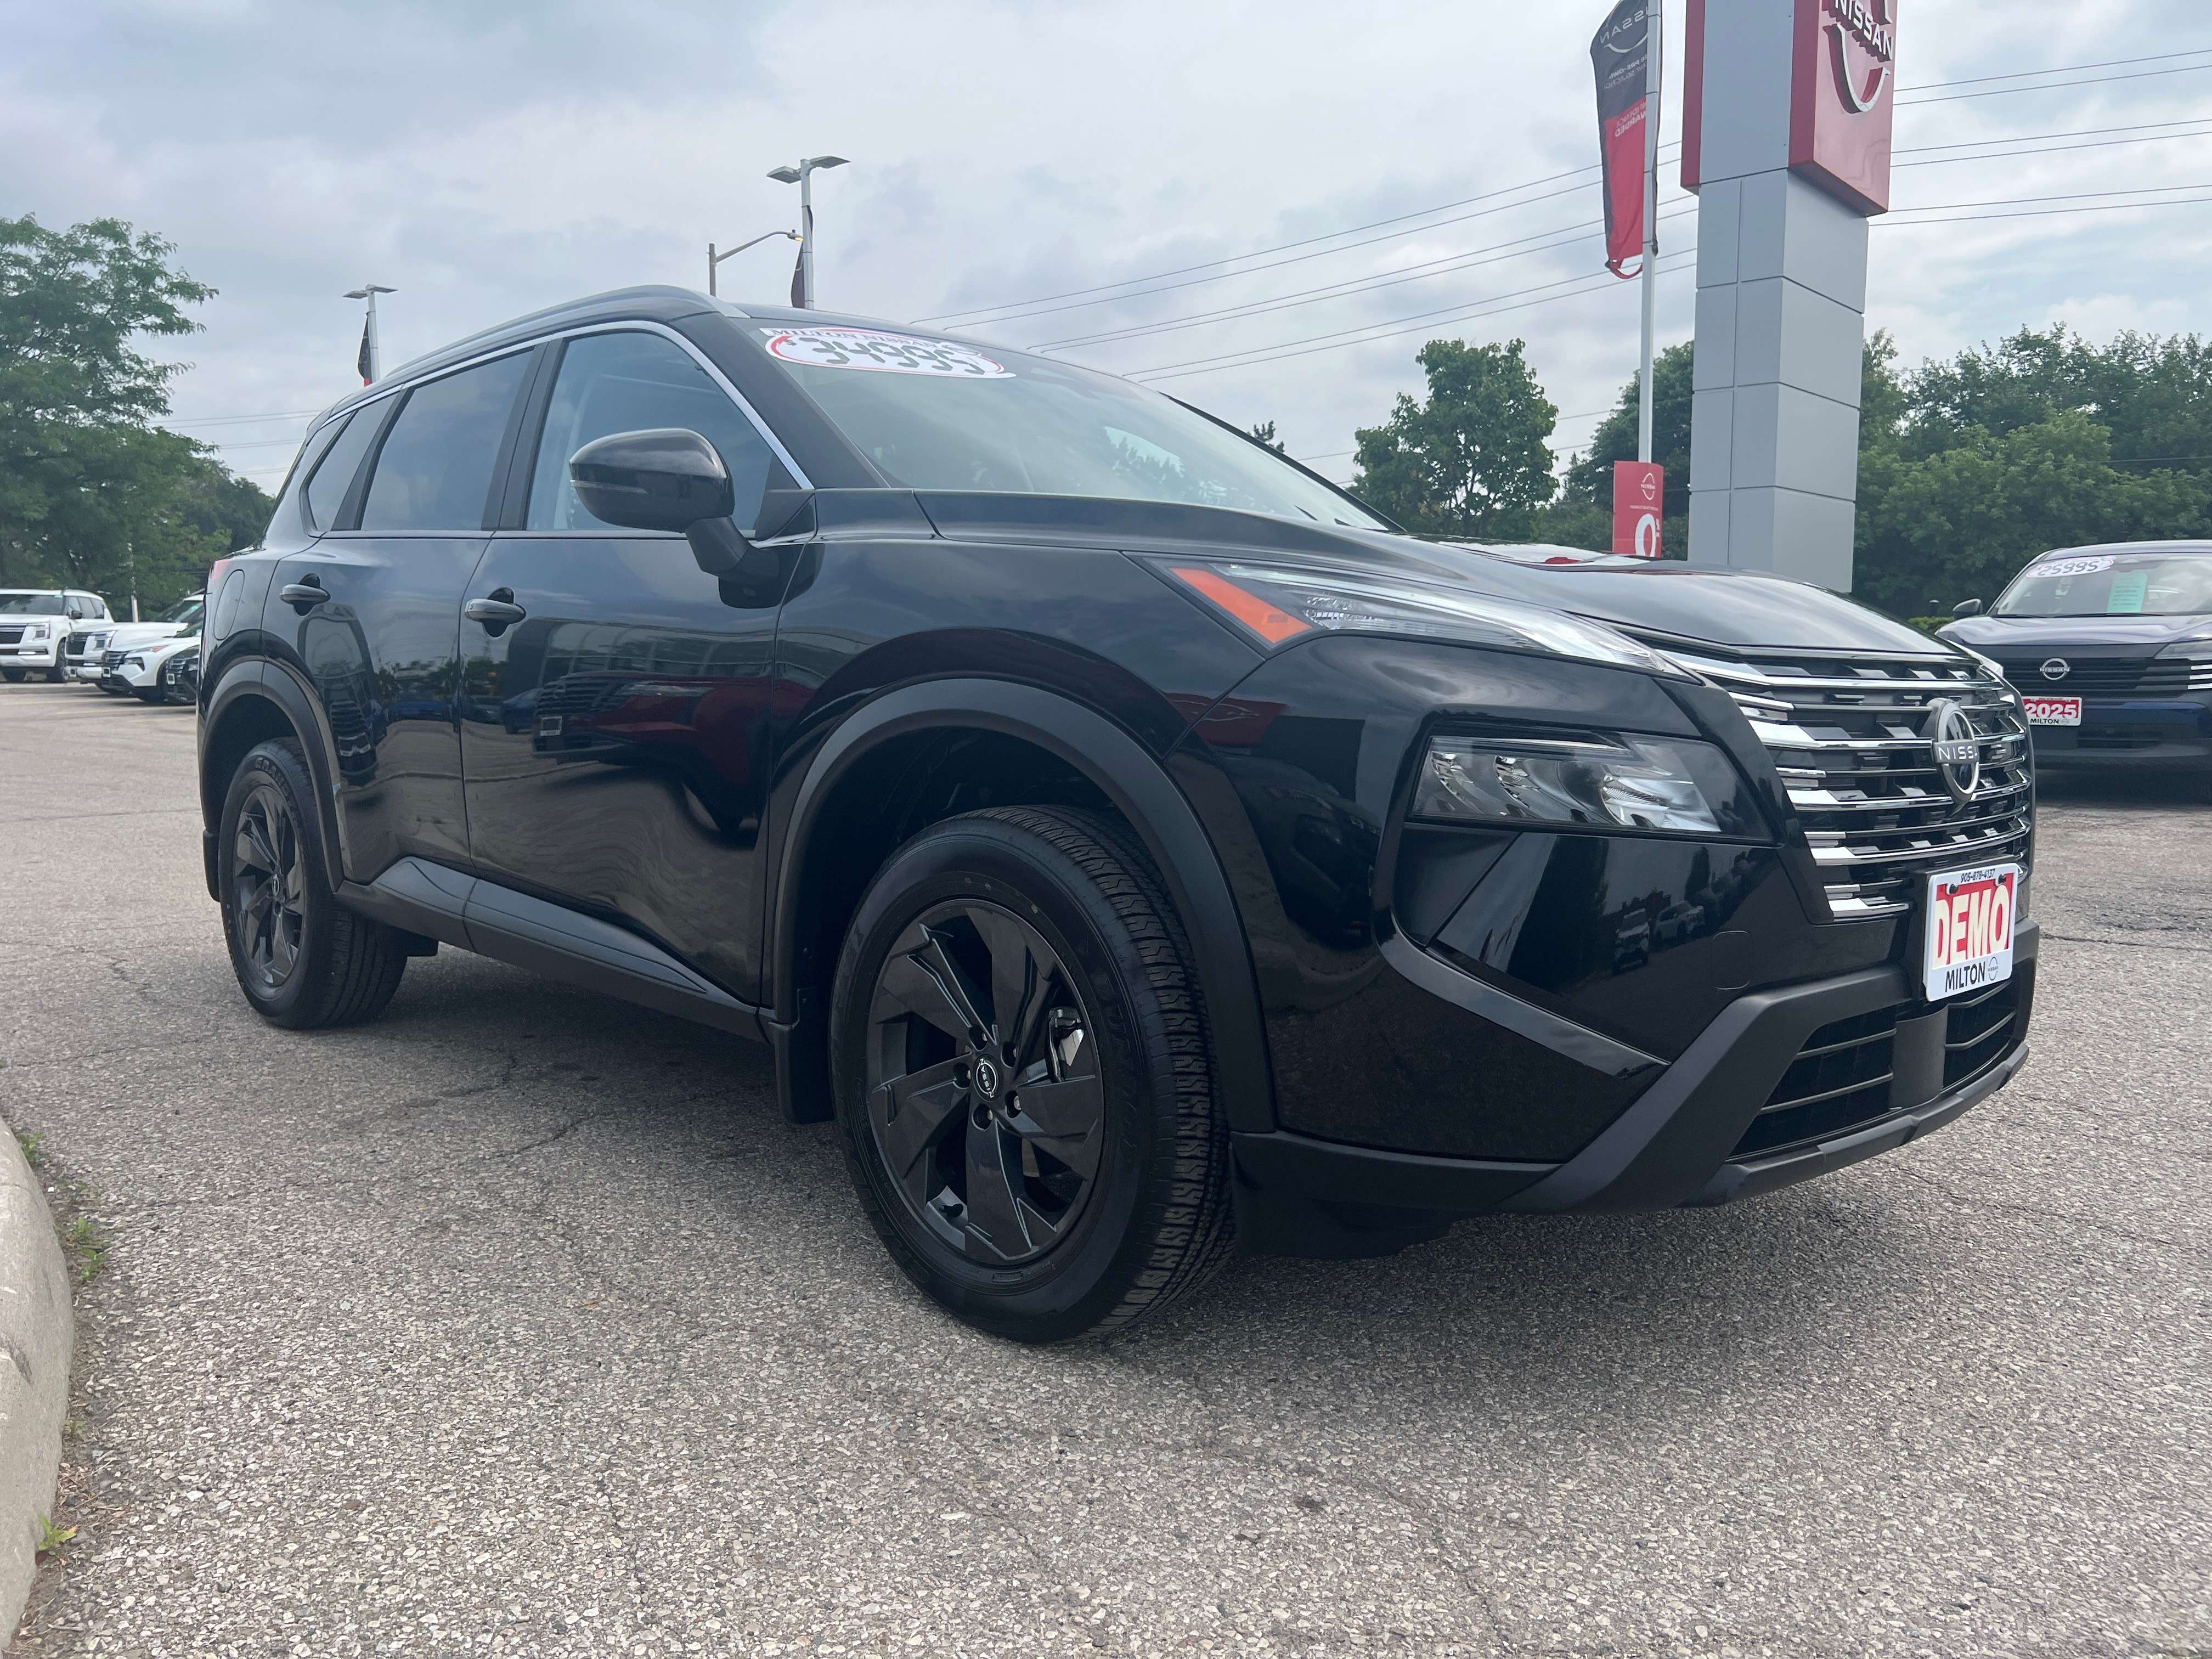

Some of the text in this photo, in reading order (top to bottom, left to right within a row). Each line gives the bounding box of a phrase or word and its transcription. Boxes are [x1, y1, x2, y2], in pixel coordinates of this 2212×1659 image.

[1835, 0, 1894, 60] NISSAN
[772, 329, 855, 340] MILTON
[798, 337, 985, 375] 34995
[2038, 561, 2099, 576] 25995
[2024, 703, 2077, 719] 2025
[1938, 746, 1978, 760] NISS
[1932, 884, 2010, 967] DEMO
[1945, 961, 1985, 992] MILTON
[979, 1058, 994, 1098] NISSAN
